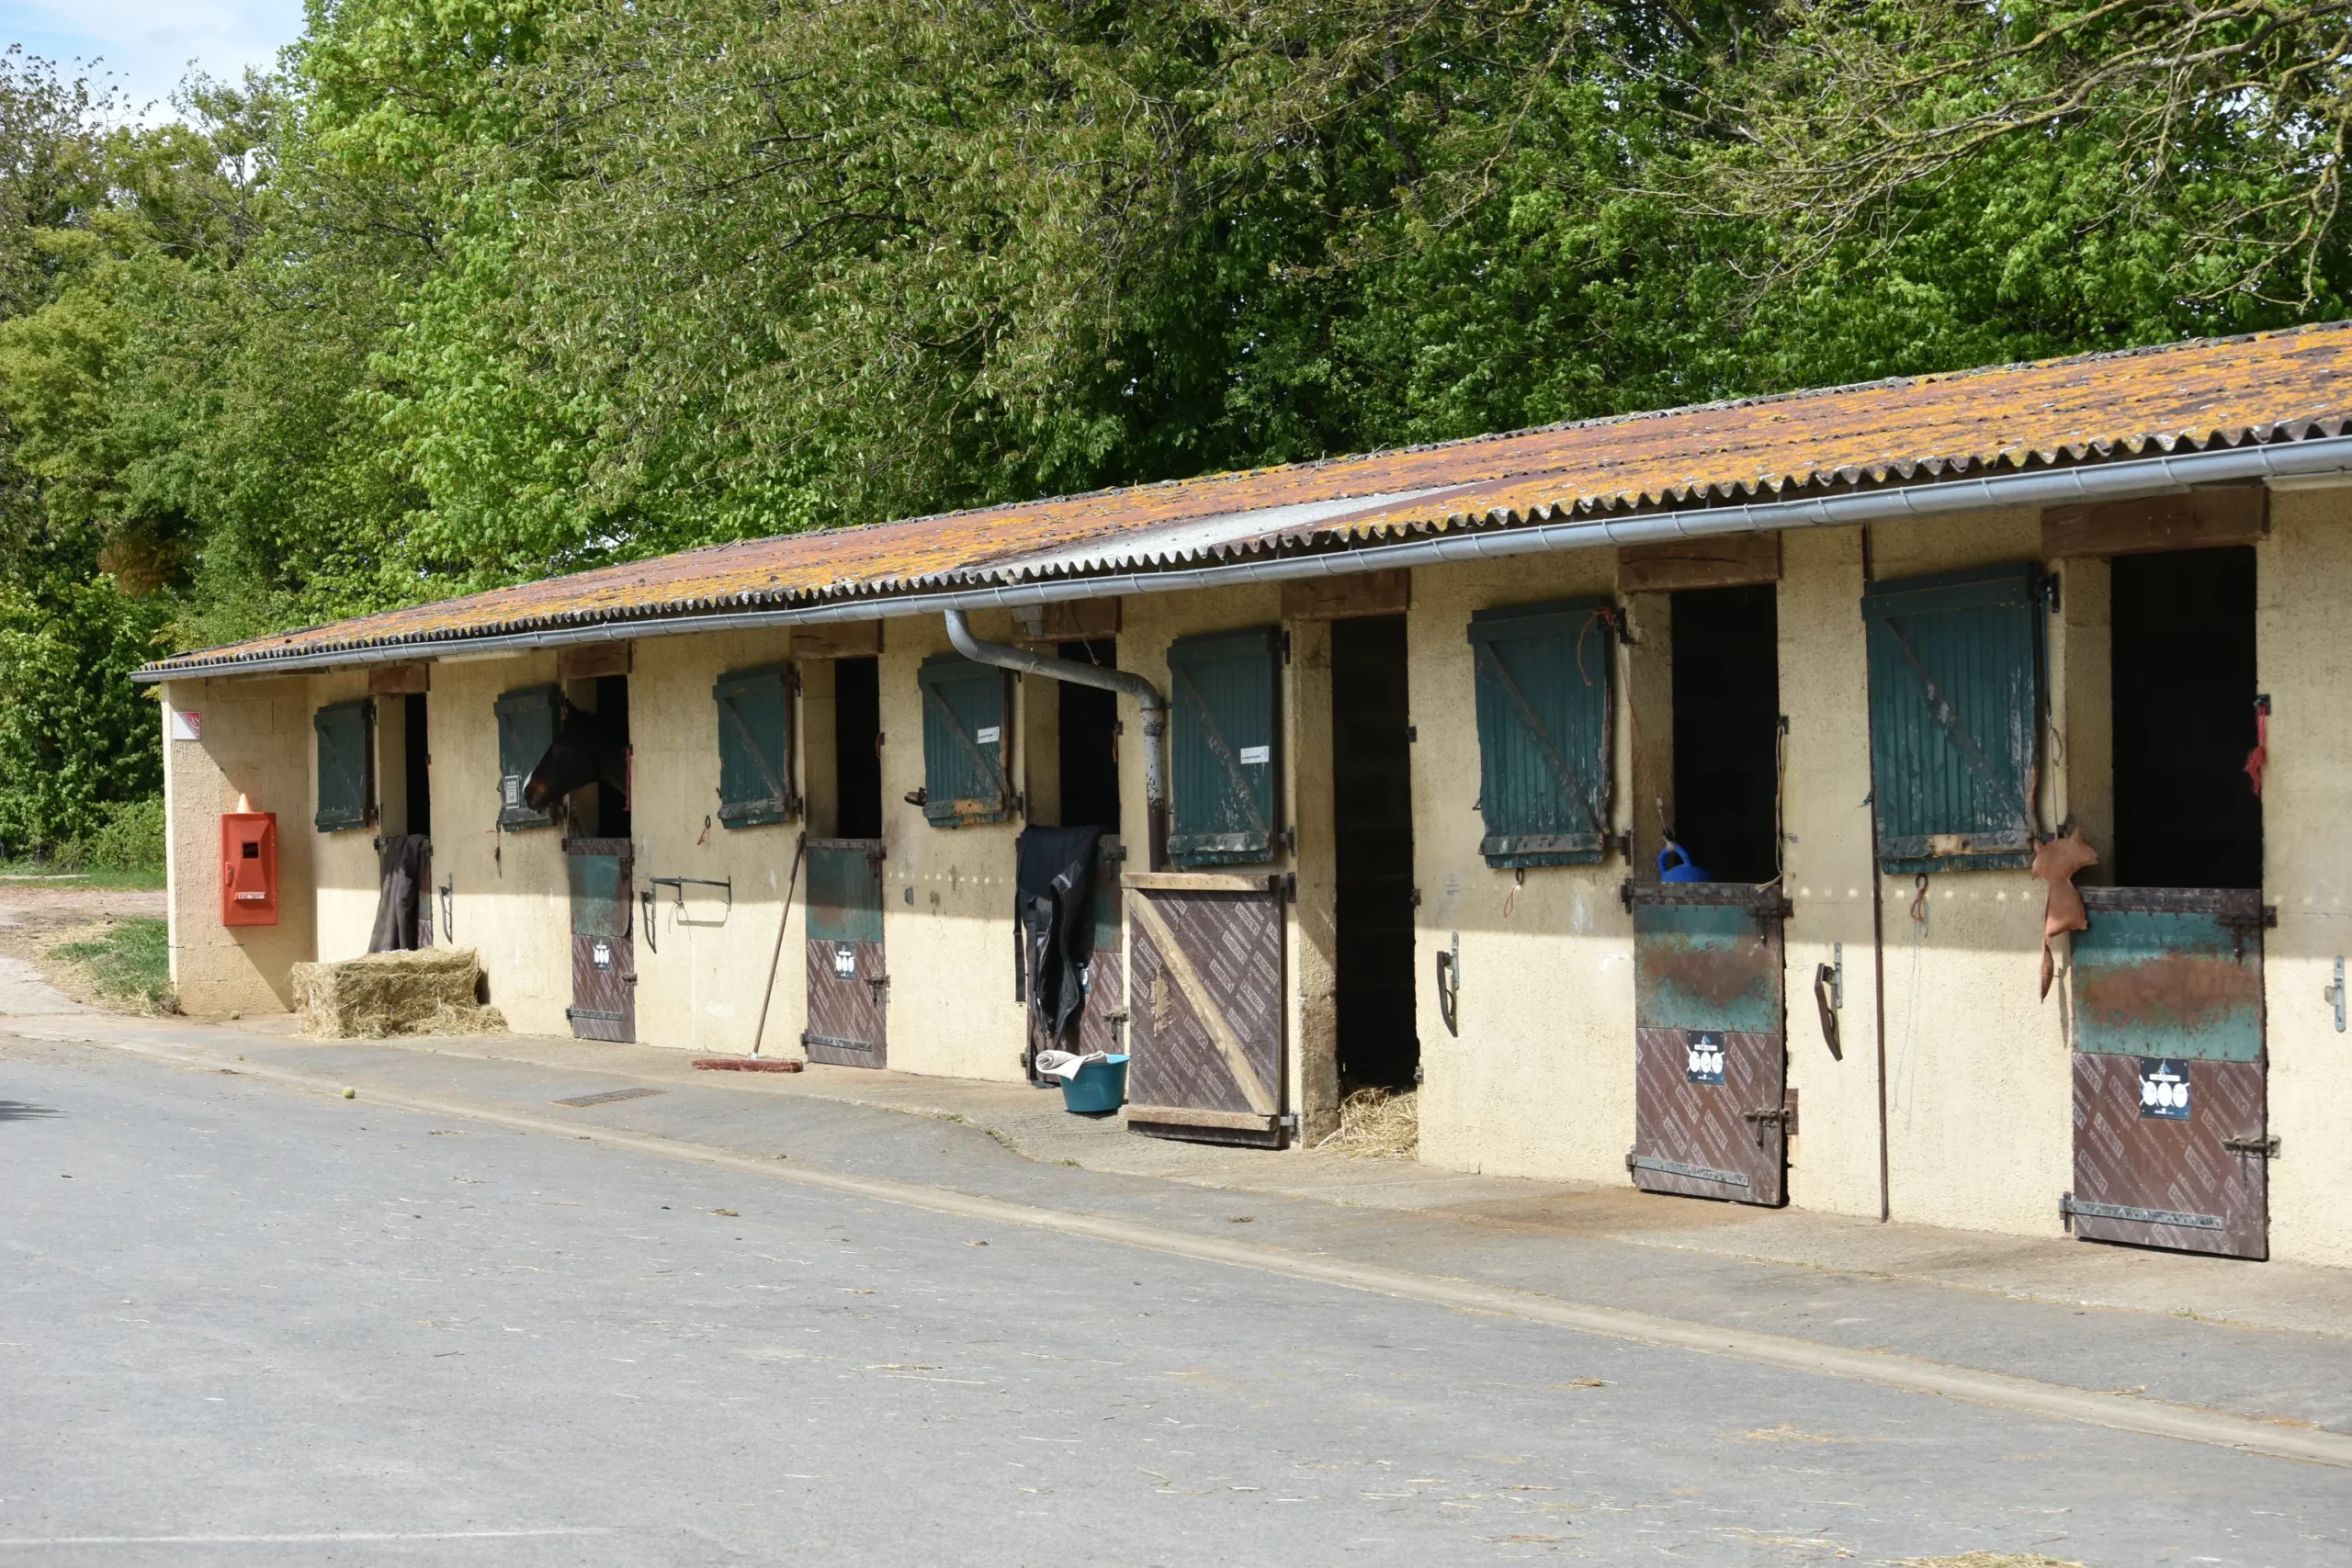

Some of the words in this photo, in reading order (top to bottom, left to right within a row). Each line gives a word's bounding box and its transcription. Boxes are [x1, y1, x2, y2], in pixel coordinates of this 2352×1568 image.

[1236, 903, 1260, 935] ULTIBAT
[1138, 938, 1161, 968] ULTIBAT
[1223, 931, 1247, 964] ULTIBAT
[1210, 960, 1233, 992] ULTIBAT
[1254, 952, 1277, 985] ULTIBAT
[1241, 980, 1264, 1012] ULTIBAT
[2109, 1077, 2139, 1122] ULTIBAT
[1705, 1110, 1727, 1150] ULTIBAT
[2095, 1113, 2123, 1158] ULTIBAT
[2079, 1149, 2108, 1194] ULTIBAT
